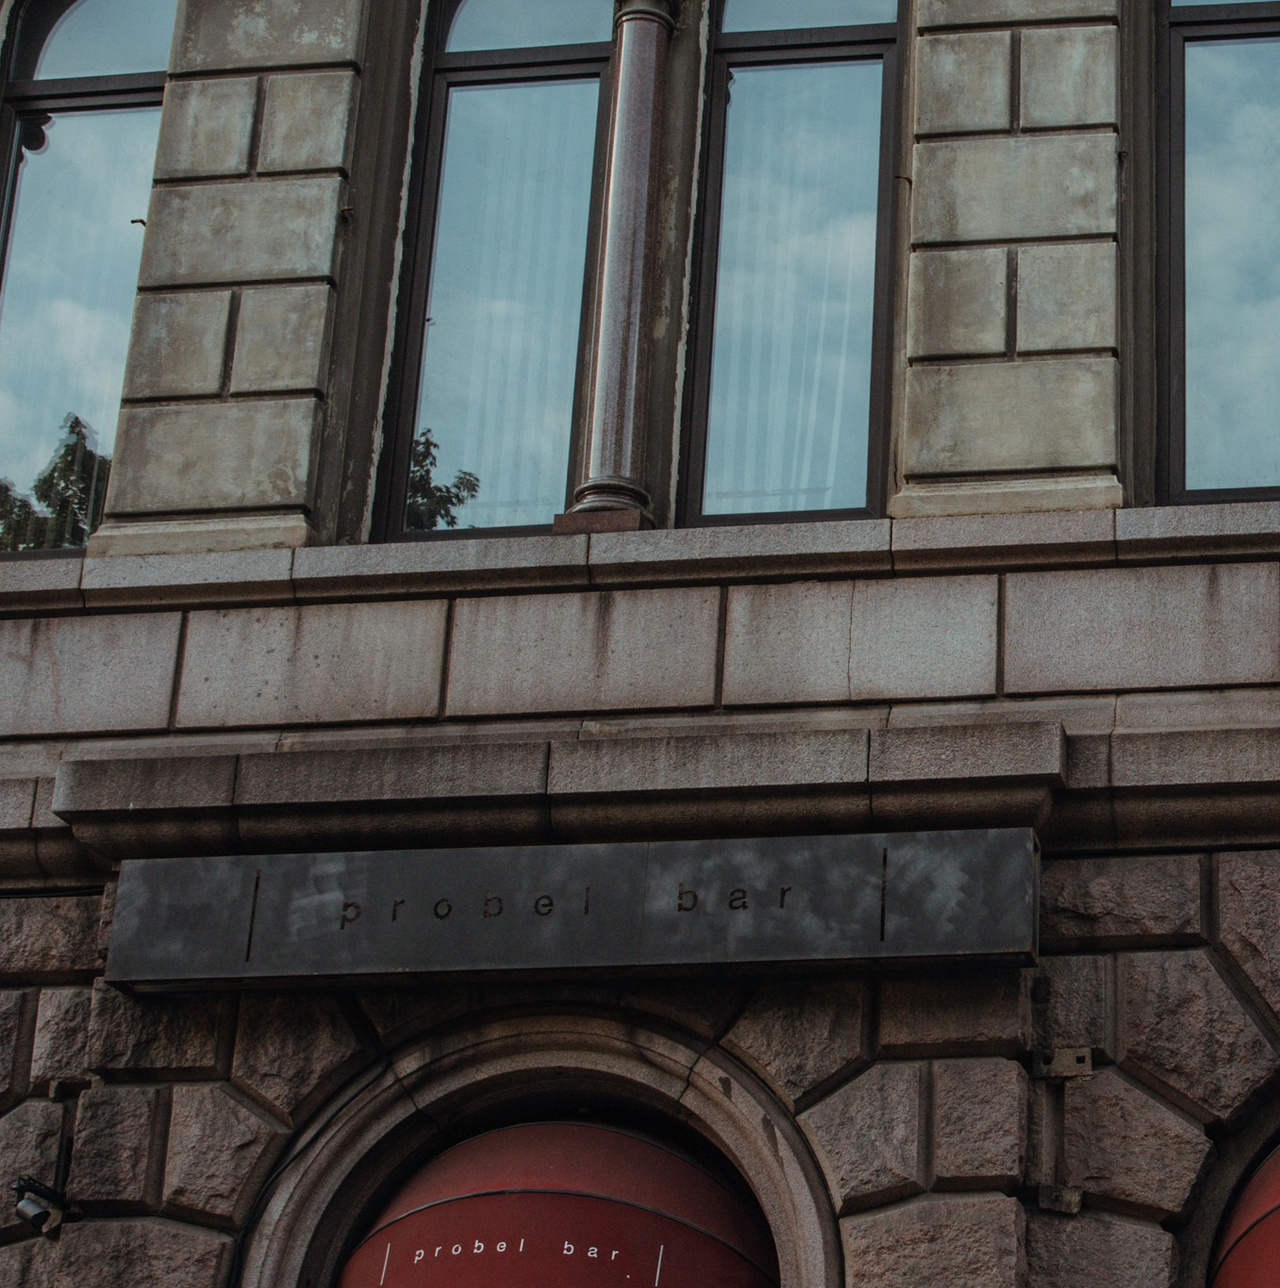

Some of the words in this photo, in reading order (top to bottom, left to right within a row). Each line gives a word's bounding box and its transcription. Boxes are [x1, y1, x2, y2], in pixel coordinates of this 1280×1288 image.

[339, 886, 591, 930] probel
[677, 882, 793, 913] bar
[413, 1237, 525, 1264] probel
[562, 1240, 620, 1261] bar
